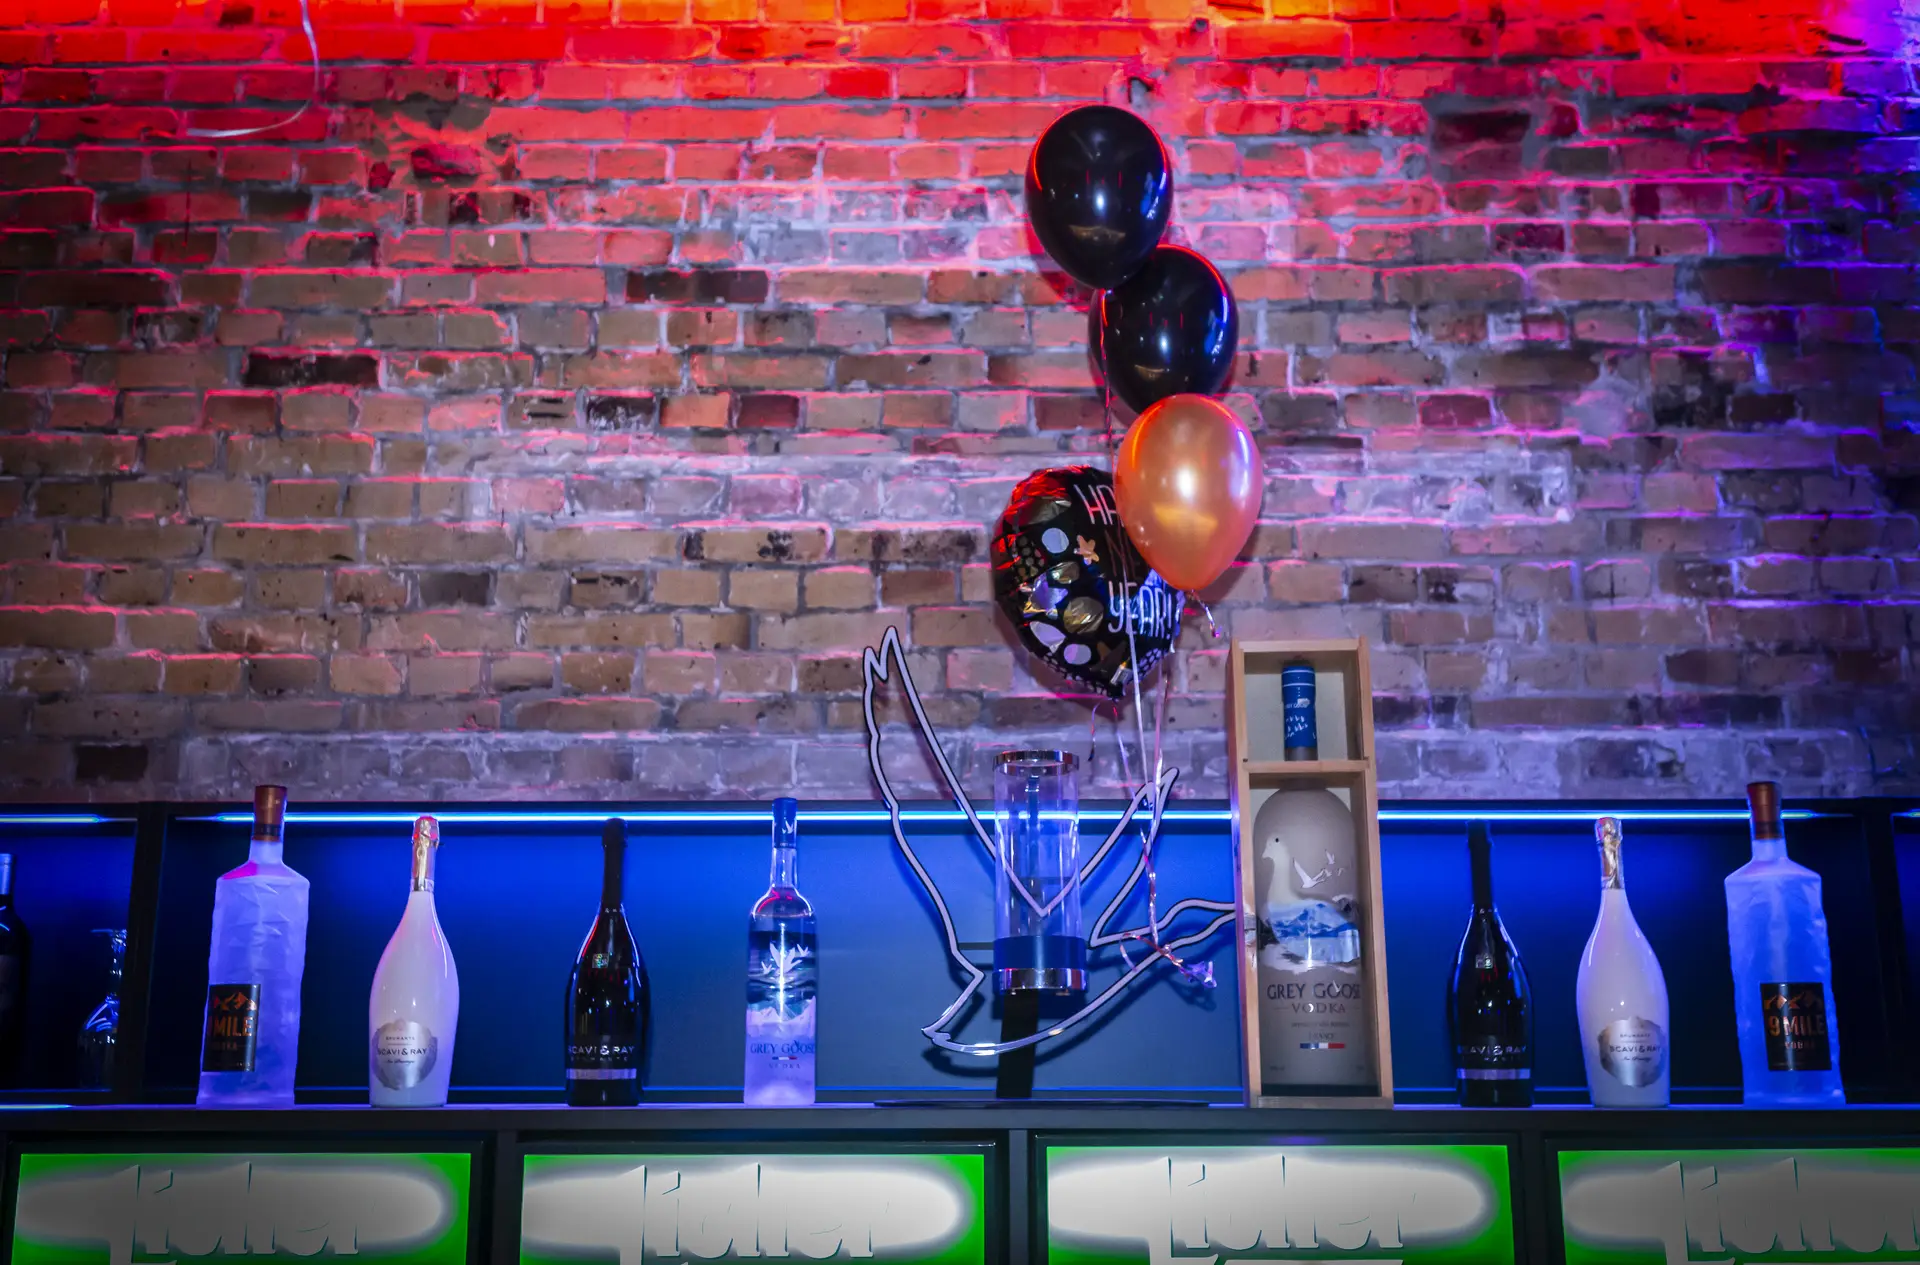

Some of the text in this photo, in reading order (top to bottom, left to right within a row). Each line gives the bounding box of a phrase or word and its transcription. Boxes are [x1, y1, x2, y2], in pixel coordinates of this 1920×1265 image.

[1107, 580, 1172, 640] YEAR!
[1266, 983, 1306, 1000] GREY
[213, 1015, 253, 1037] MILE
[1783, 1015, 1825, 1036] MILE
[401, 1047, 409, 1056] &
[410, 1047, 428, 1056] RAY
[599, 1045, 610, 1056] &
[613, 1045, 636, 1054] RAY
[750, 1042, 777, 1055] GREY
[1492, 1045, 1503, 1056] &
[1638, 1045, 1647, 1054] &
